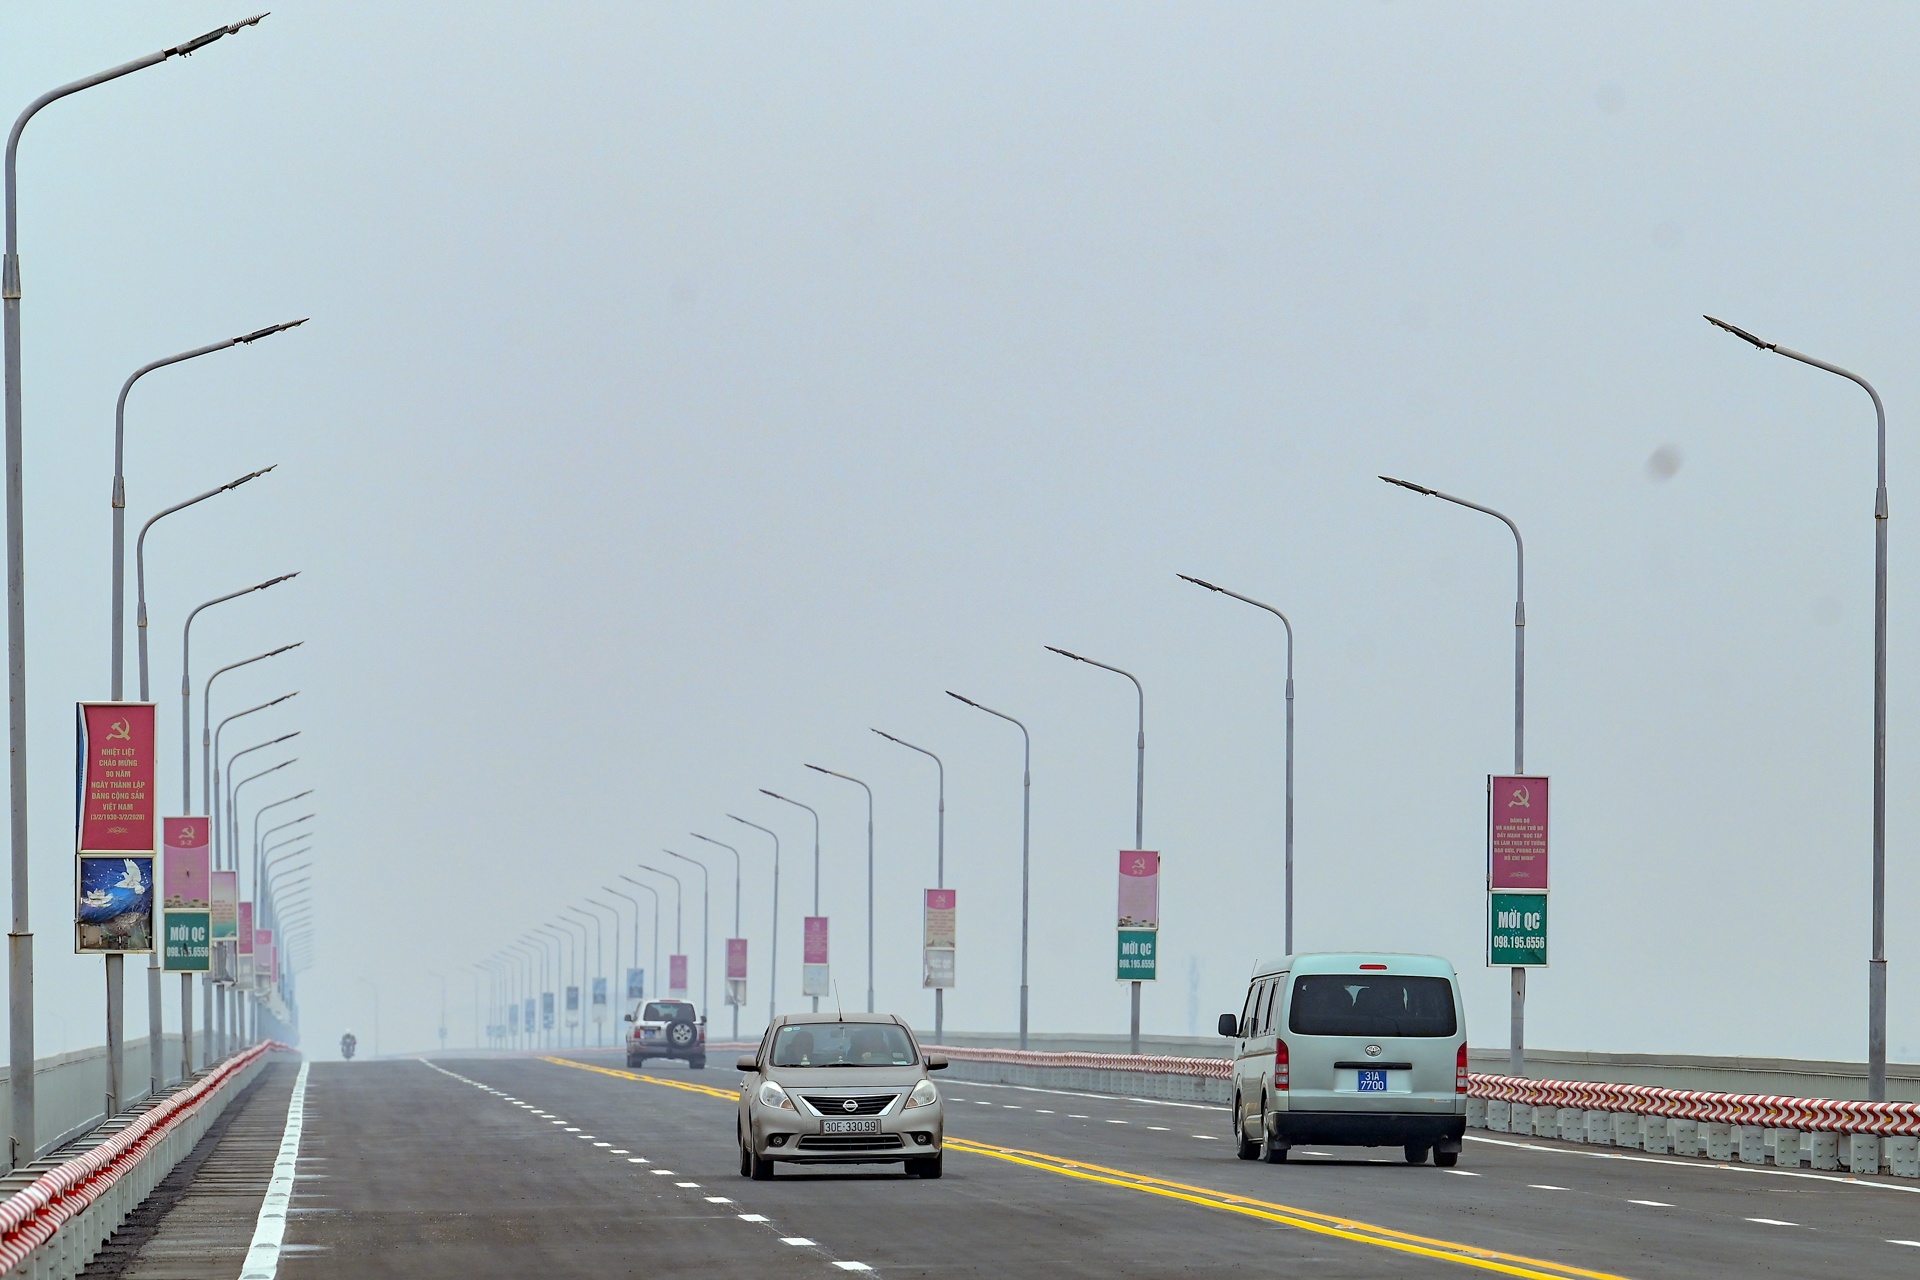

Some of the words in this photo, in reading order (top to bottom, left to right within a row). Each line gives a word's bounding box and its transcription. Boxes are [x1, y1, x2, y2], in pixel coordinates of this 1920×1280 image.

[101, 748, 120, 757] NHIỆT
[122, 748, 135, 757] LIỆT
[99, 758, 116, 766] CHÀO
[118, 758, 137, 766] MỪNG
[116, 769, 131, 777] NĂM
[92, 780, 108, 788] NGÀY
[110, 780, 131, 788] THÀNH
[133, 780, 145, 790] LẬP
[92, 790, 109, 799] ĐẢNG
[112, 791, 129, 801] CỘNG
[131, 790, 144, 799] SẢN
[103, 802, 116, 811] VIỆT
[1498, 908, 1520, 928] MỜI
[1524, 912, 1540, 931] QC
[170, 924, 189, 941] MỜI
[191, 926, 205, 942] QC
[1494, 935, 1545, 949] 098.195.6556
[1122, 940, 1138, 955] MỜI
[1140, 943, 1151, 956] QC
[1365, 1072, 1379, 1081] 31A
[1361, 1081, 1384, 1090] 7700
